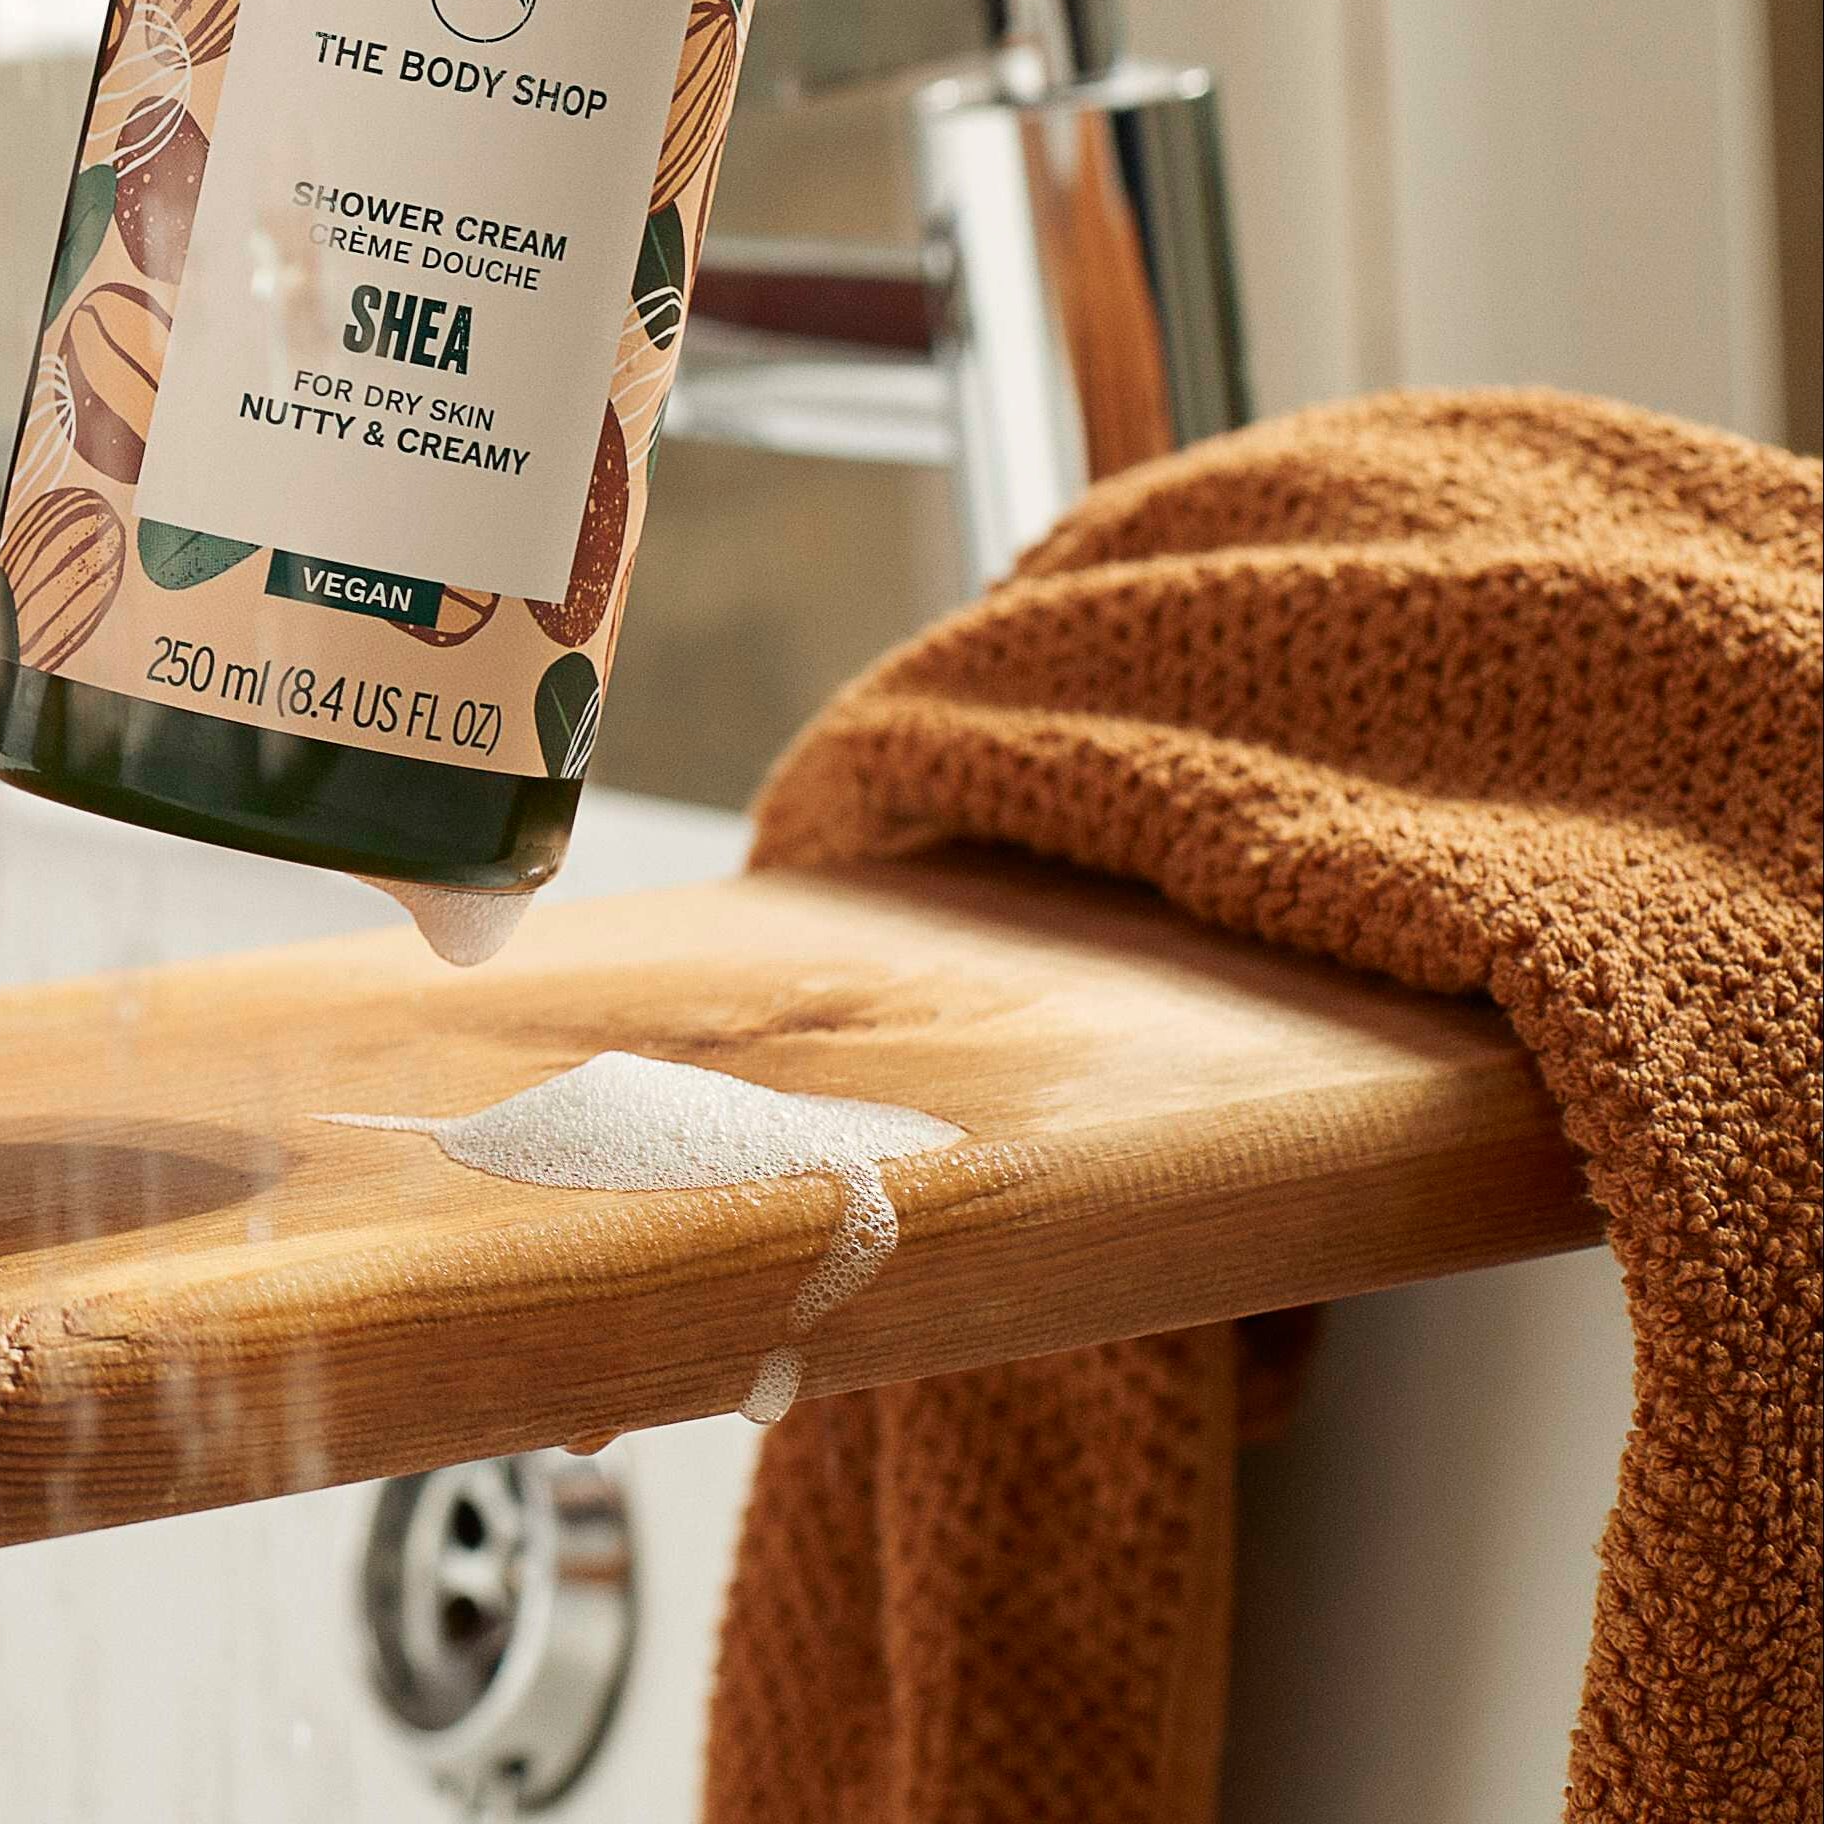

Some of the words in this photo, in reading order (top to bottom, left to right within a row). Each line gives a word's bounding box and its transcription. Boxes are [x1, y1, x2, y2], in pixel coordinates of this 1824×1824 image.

[314, 31, 388, 76] THE
[398, 50, 508, 99] BODY
[512, 73, 608, 121] SHOP
[291, 180, 445, 237] SHOWER
[455, 214, 569, 262] CREAM
[308, 219, 411, 265] CRÈME
[421, 246, 542, 292] DOUCHE
[341, 283, 474, 376] SHEA
[238, 392, 358, 441] NUTTY
[362, 420, 386, 449] &
[396, 427, 532, 476] CREAMY
[293, 370, 354, 403] FOR
[363, 384, 424, 418] DRY
[428, 399, 496, 432] SKIN
[301, 566, 413, 613] VEGAN
[145, 635, 216, 693] 250
[219, 659, 273, 707] ml
[276, 665, 347, 723] (8.4
[352, 679, 401, 734] US
[406, 692, 444, 743] FL
[451, 699, 503, 757] OZ)
